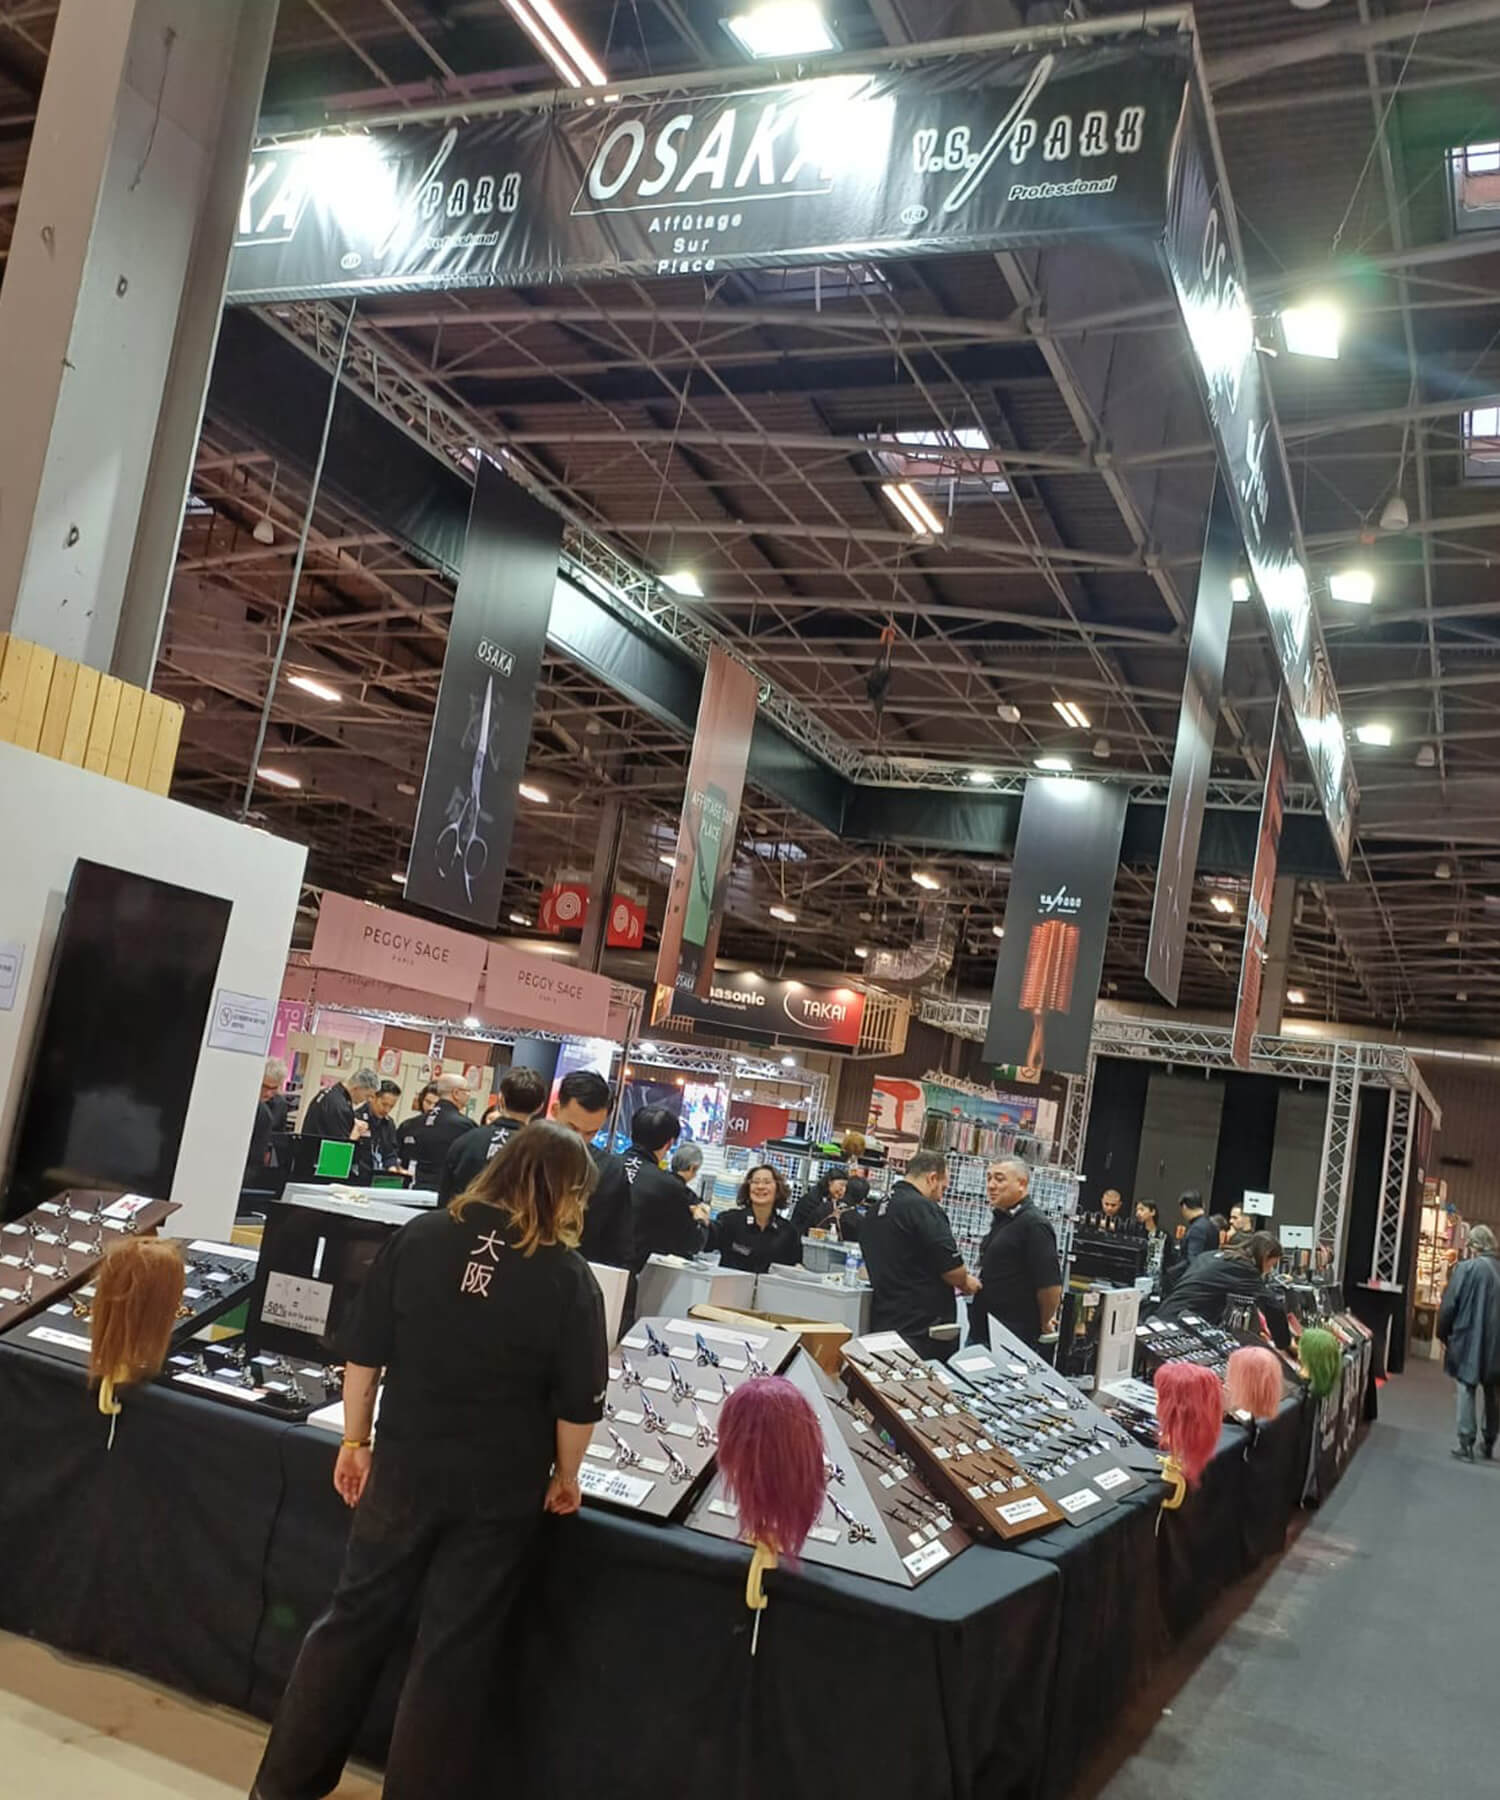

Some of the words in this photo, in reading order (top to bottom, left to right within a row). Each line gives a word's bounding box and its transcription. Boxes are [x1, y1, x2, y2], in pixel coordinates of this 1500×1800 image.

[1009, 106, 1146, 165] PARK
[422, 172, 522, 221] PARK
[1008, 175, 1118, 201] Professional
[673, 237, 709, 253] Sur
[657, 259, 716, 275] Place
[477, 640, 514, 676] OSAKA
[363, 926, 413, 951] PEGGY
[415, 940, 450, 963] SAGE
[517, 969, 555, 992] PEGGY
[556, 981, 584, 1000] SAGE
[803, 999, 847, 1021] TAKAI
[460, 1229, 506, 1297] 大阪
